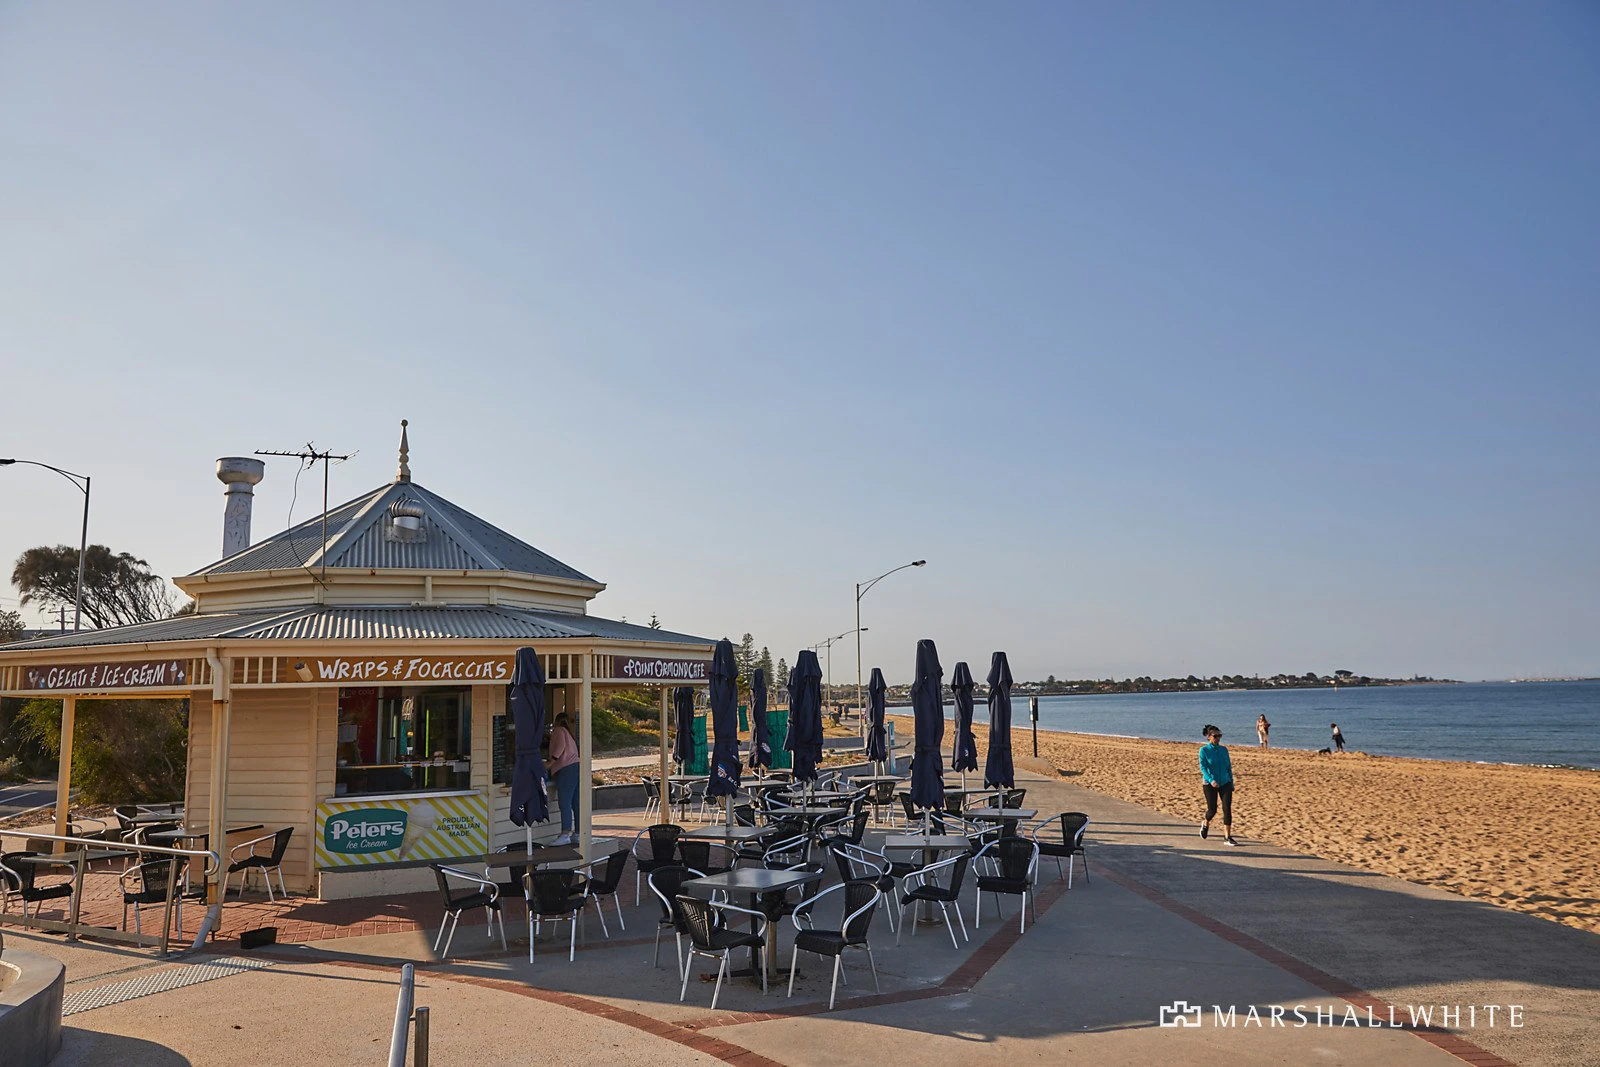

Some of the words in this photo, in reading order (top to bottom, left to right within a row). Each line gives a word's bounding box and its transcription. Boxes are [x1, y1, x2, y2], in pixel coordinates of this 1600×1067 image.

[47, 667, 87, 688] GELATI
[90, 666, 98, 686] &
[99, 663, 166, 687] ICE-CREAM
[318, 659, 388, 679] WRAPS
[392, 659, 403, 680] &
[403, 658, 507, 680] FOCACCIAS
[624, 659, 654, 677] POINT
[654, 659, 688, 678] ORMOND
[688, 662, 705, 679] CAFE
[437, 822, 480, 831] AUSTRALIAN
[442, 815, 475, 824] PROUDLY
[330, 819, 405, 840] Peters
[448, 830, 470, 838] MADE
[346, 840, 358, 848] Ice
[360, 839, 388, 848] Cream
